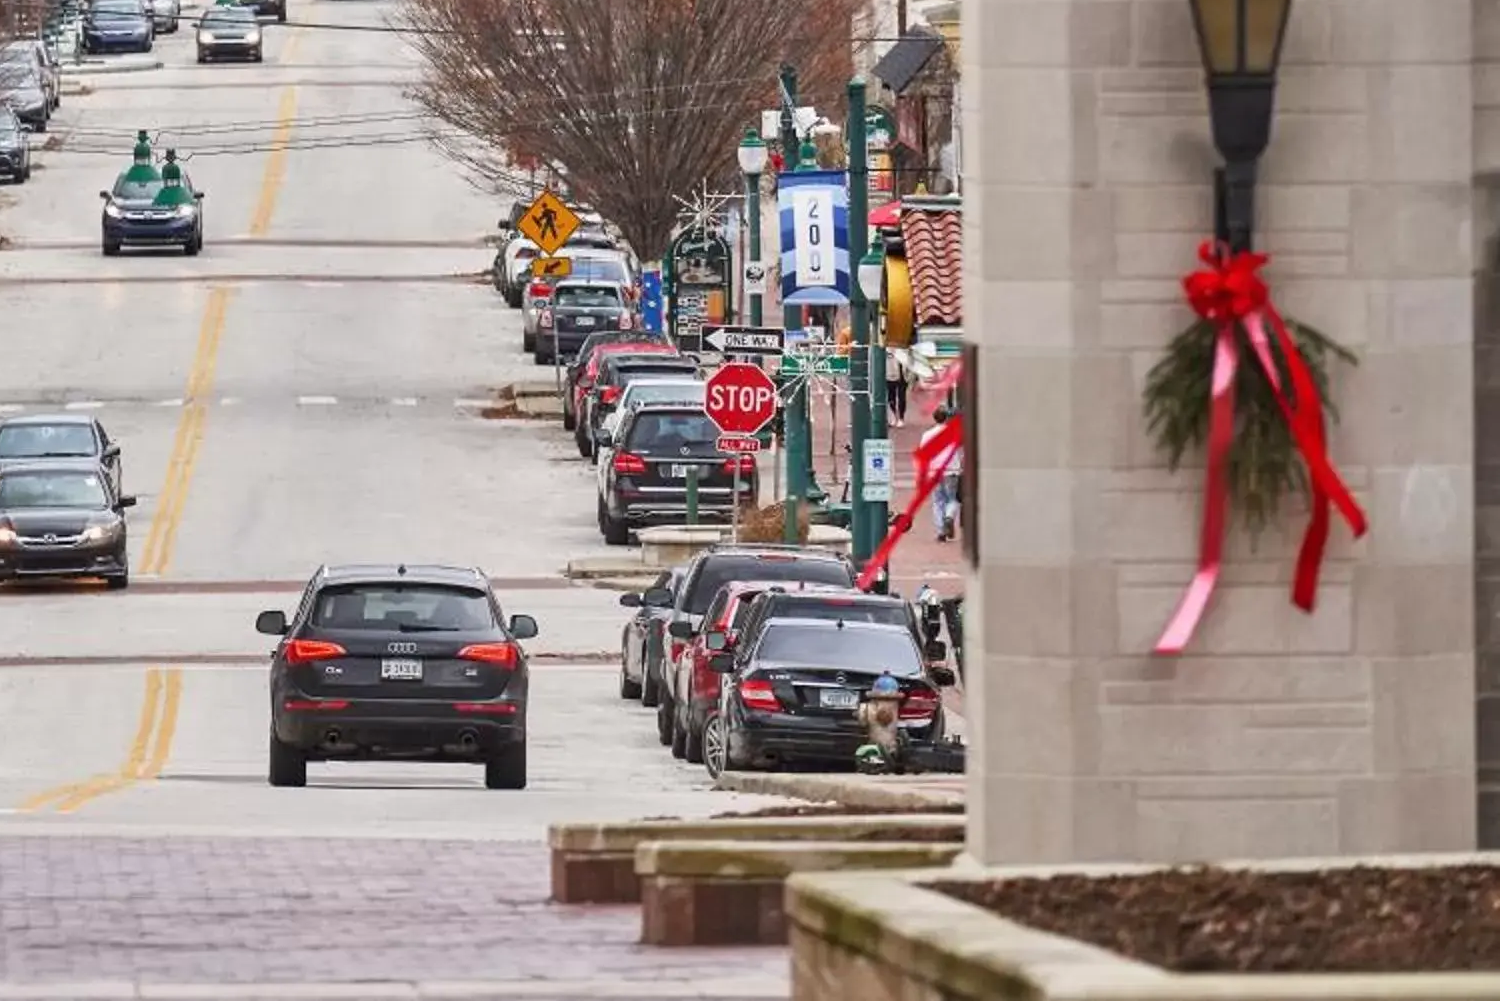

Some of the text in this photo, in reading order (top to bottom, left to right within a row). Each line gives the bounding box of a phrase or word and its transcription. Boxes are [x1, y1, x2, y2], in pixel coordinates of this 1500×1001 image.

[808, 199, 820, 272] 200
[725, 334, 777, 348] ONE WAY
[710, 385, 771, 413] STOP
